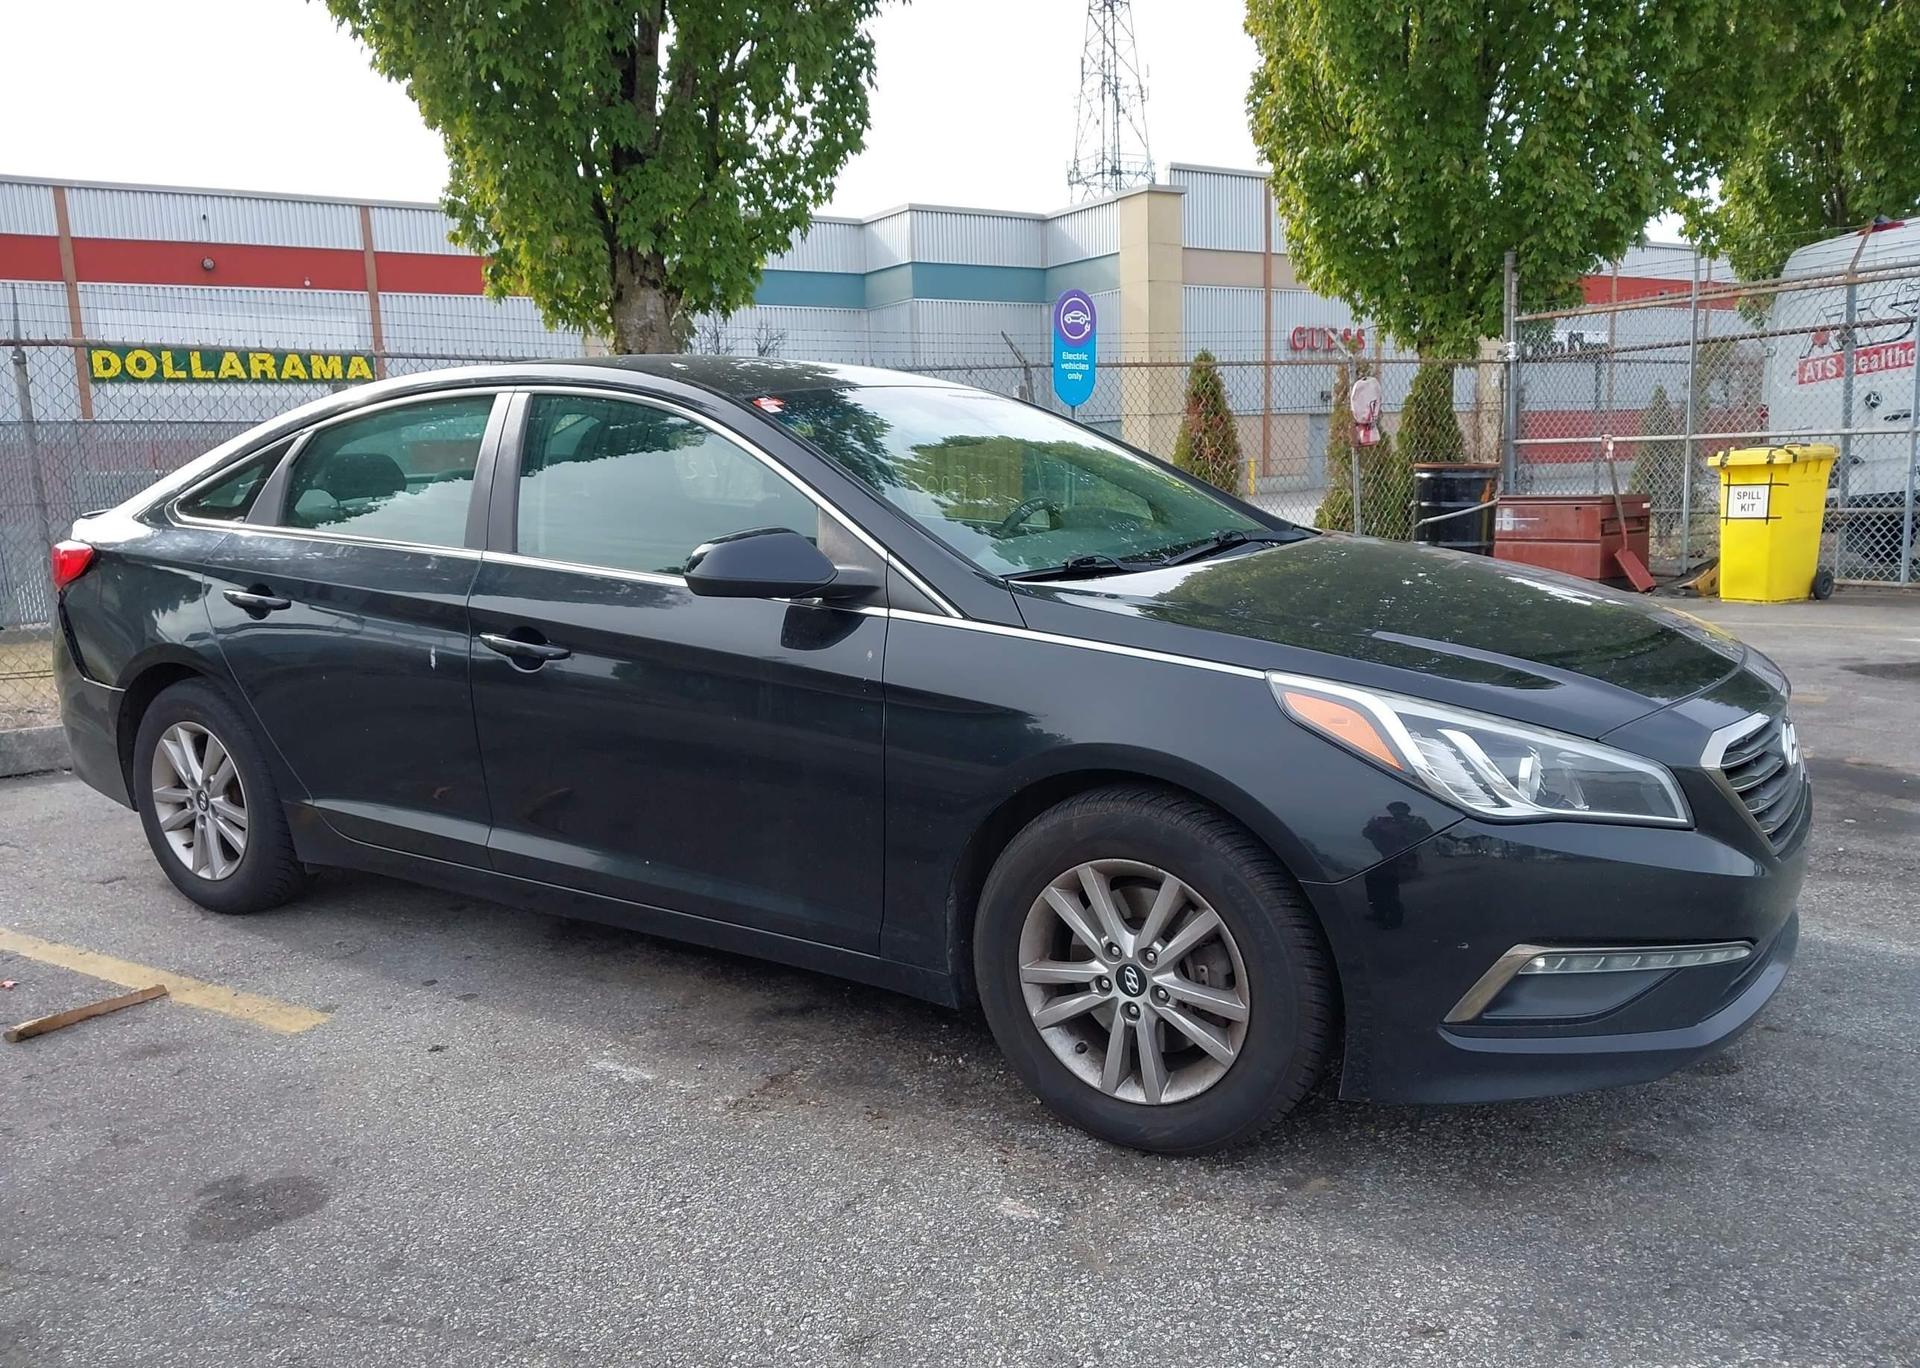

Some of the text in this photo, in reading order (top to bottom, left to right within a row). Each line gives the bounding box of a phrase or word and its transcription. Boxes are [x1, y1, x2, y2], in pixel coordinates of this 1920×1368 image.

[1062, 351, 1089, 361] Electric
[91, 350, 374, 380] DOLLARAMA
[1060, 361, 1090, 370] vehicles
[1804, 357, 1838, 381] ATS
[1067, 372, 1083, 382] only
[1736, 491, 1761, 500] SPILL
[1740, 503, 1756, 512] KIT
